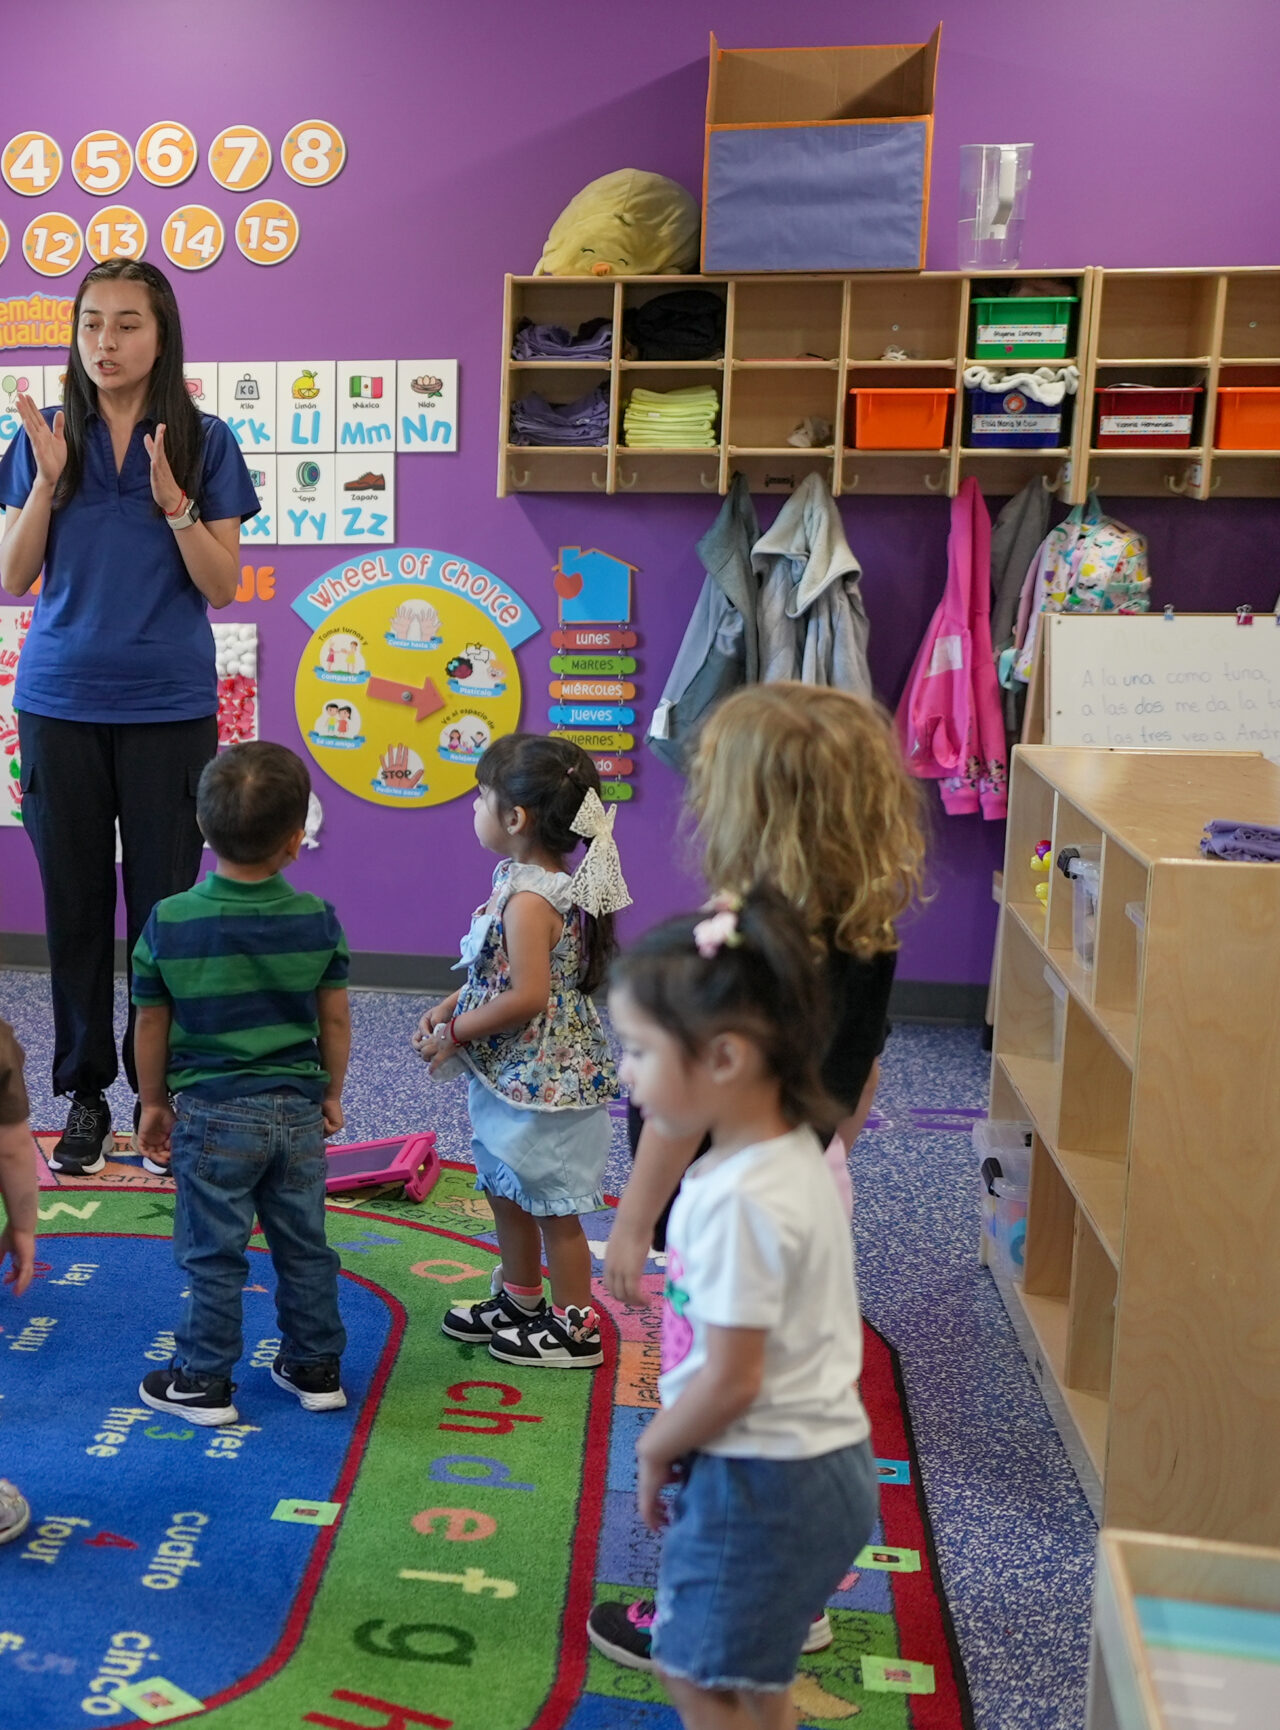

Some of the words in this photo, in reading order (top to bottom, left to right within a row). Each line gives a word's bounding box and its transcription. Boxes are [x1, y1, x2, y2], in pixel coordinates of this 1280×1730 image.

[9, 139, 51, 187] 4
[85, 140, 120, 189] 5
[146, 128, 184, 177] 6
[223, 137, 258, 183] 7
[291, 129, 331, 178] 8
[32, 228, 74, 267] 12
[94, 222, 139, 257] 13
[171, 220, 215, 259] 14
[244, 216, 289, 251] 15
[227, 416, 271, 445] Kk
[291, 411, 320, 445] Ll
[340, 421, 392, 445] Mm
[402, 414, 452, 445] Nn
[287, 508, 327, 541] Yy
[341, 507, 388, 537] Zz
[1082, 669, 1095, 688] A
[1123, 672, 1155, 687] una
[1166, 670, 1213, 685] como
[1081, 702, 1095, 717] a
[1102, 696, 1128, 716] las
[1134, 696, 1165, 715] dos
[1082, 731, 1096, 745] a
[1106, 725, 1133, 744] las
[1140, 726, 1172, 744] tres
[380, 769, 412, 780] STOP
[410, 1258, 489, 1285] a
[5, 1316, 58, 1352] nine
[438, 1380, 544, 1435] ch
[85, 1407, 155, 1458] three
[144, 1425, 195, 1441] 3
[428, 1454, 536, 1492] d
[411, 1507, 498, 1542] e
[21, 1515, 92, 1565] four
[83, 1530, 139, 1551] 4
[140, 1510, 210, 1590] cuatro
[397, 1567, 518, 1599] f
[353, 1618, 477, 1668] g
[81, 1630, 161, 1716] cinco
